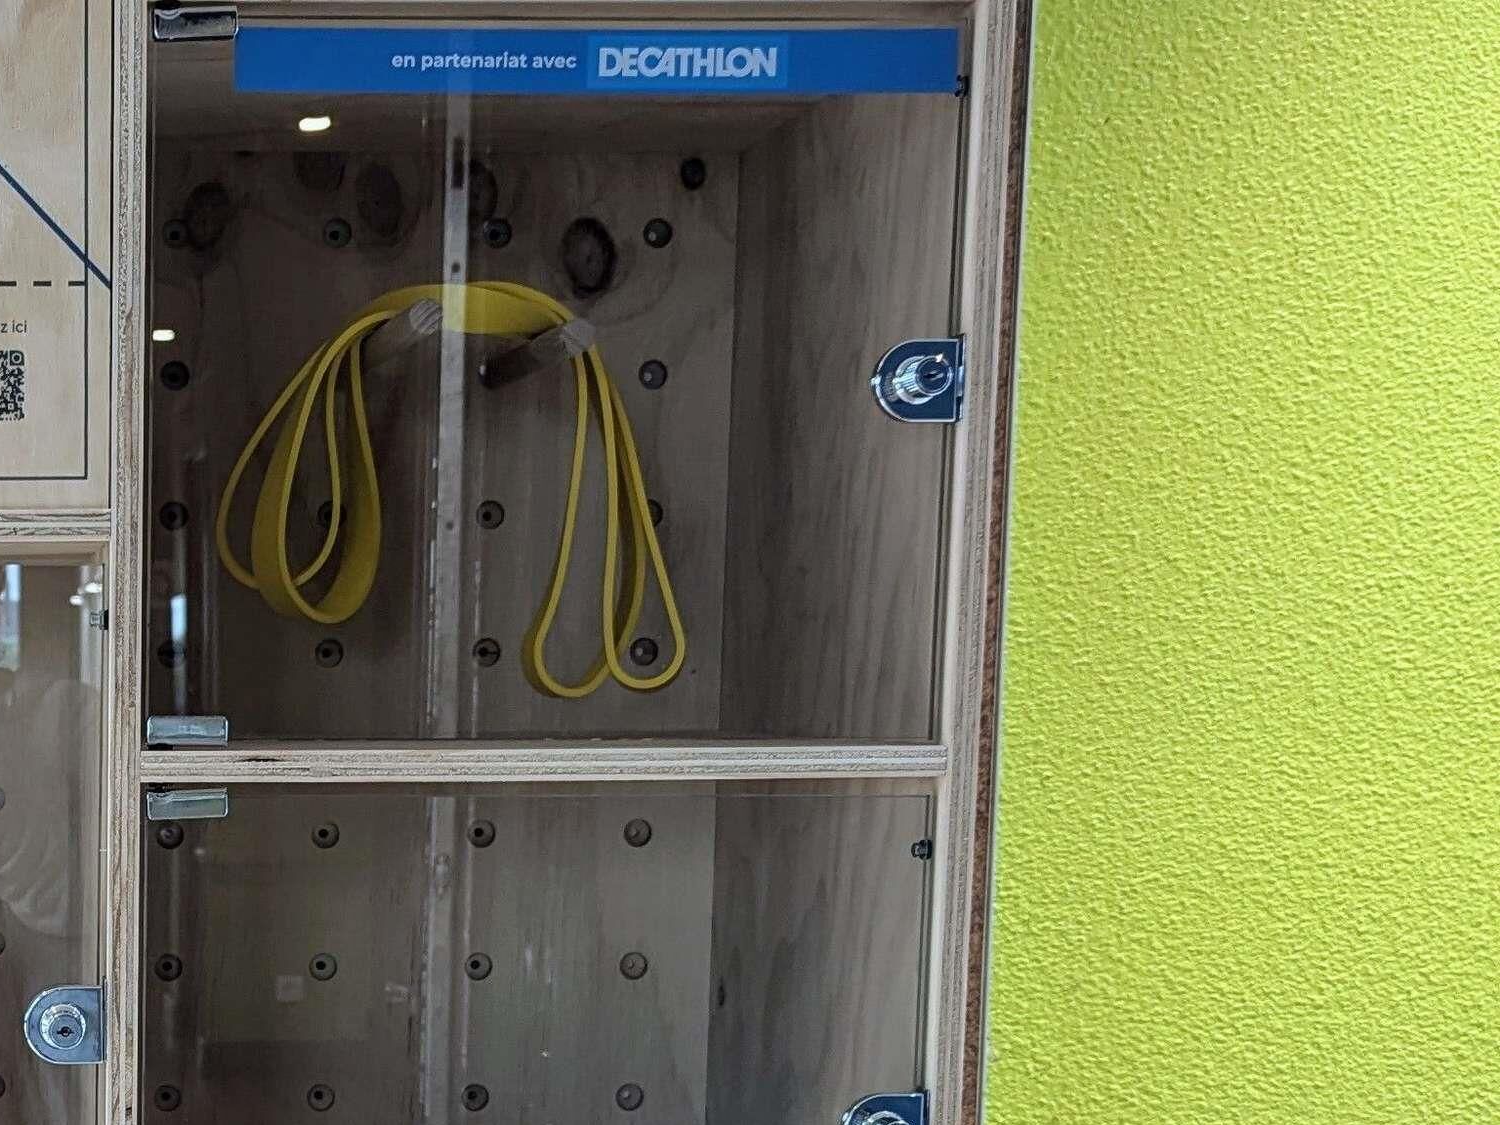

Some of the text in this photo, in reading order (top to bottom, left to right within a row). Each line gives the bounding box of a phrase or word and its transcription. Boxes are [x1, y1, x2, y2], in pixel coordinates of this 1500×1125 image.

[391, 46, 779, 78] en partenariat avec DECATHLON
[11, 320, 28, 334] ici
